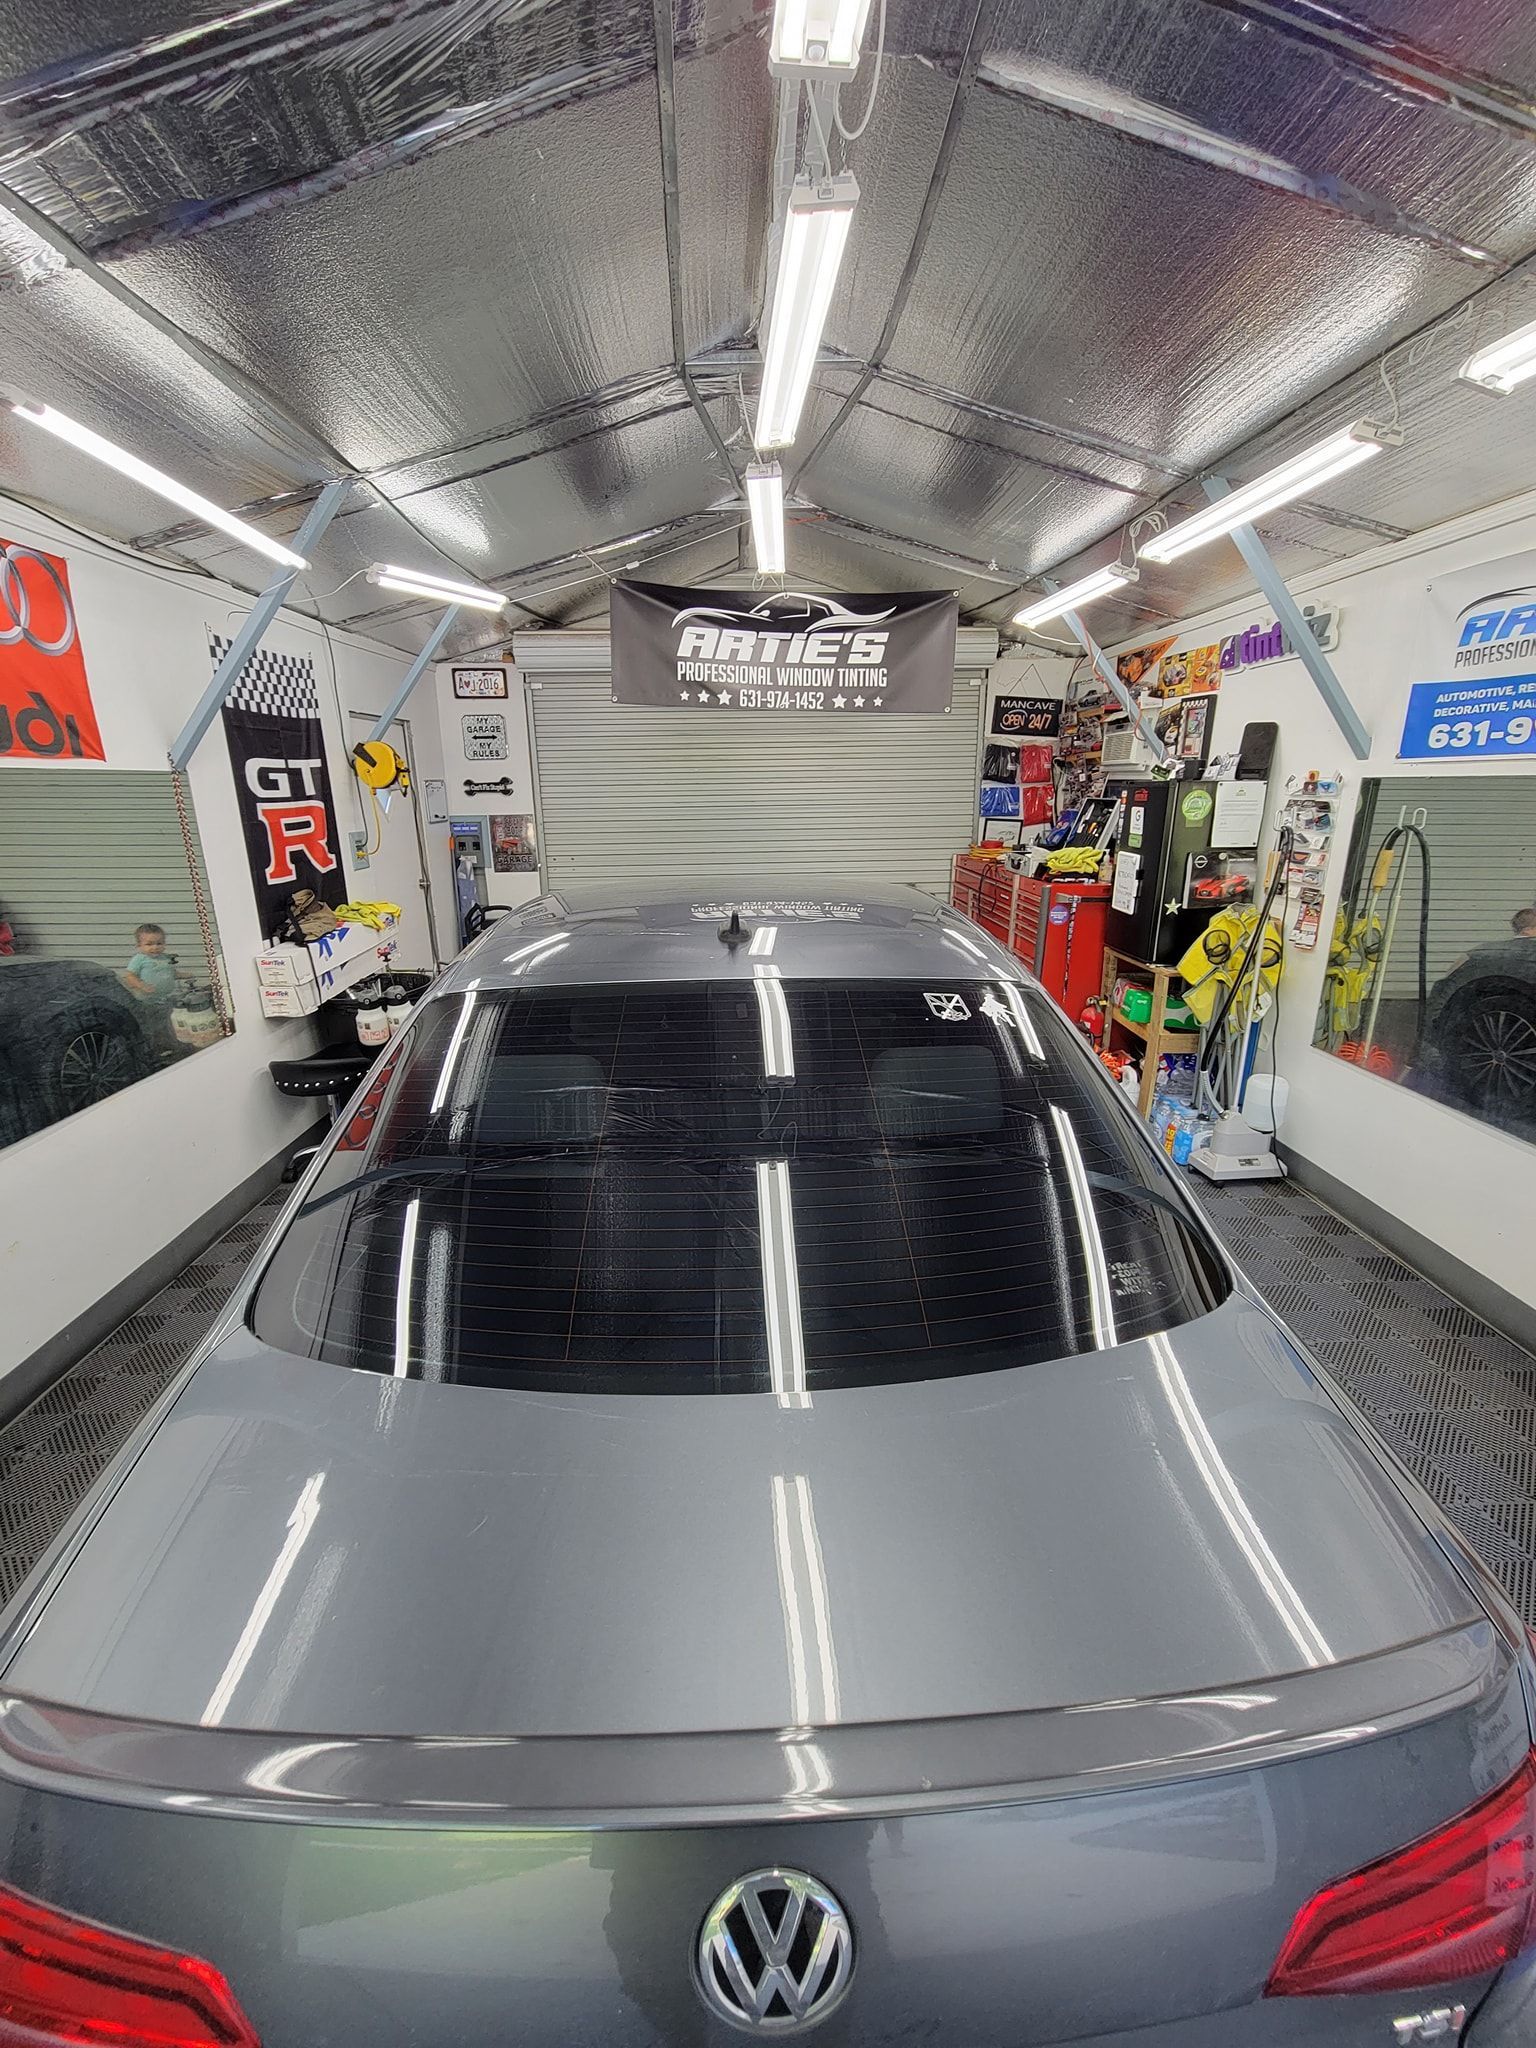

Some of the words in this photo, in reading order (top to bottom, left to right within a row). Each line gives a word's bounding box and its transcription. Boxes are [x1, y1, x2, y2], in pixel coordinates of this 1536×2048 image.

[1457, 604, 1536, 647] AR
[676, 626, 889, 665] ARTIE'S
[677, 661, 773, 687] PROFESSIONAL
[777, 667, 834, 686] WINDOW
[837, 668, 888, 688] TINTING
[739, 689, 824, 710] 631-974-1452
[1436, 685, 1516, 703] AUTOMOTIVE,
[1518, 683, 1536, 694] RE
[1000, 700, 1056, 711] MANCAVE
[1433, 701, 1509, 717] DECORATIVE,
[1002, 713, 1026, 727] OPEN
[1028, 714, 1052, 730] 24/7
[1428, 716, 1536, 749] 631-9
[244, 757, 322, 798] GT
[256, 799, 337, 886] R
[497, 855, 533, 863] GARAGE
